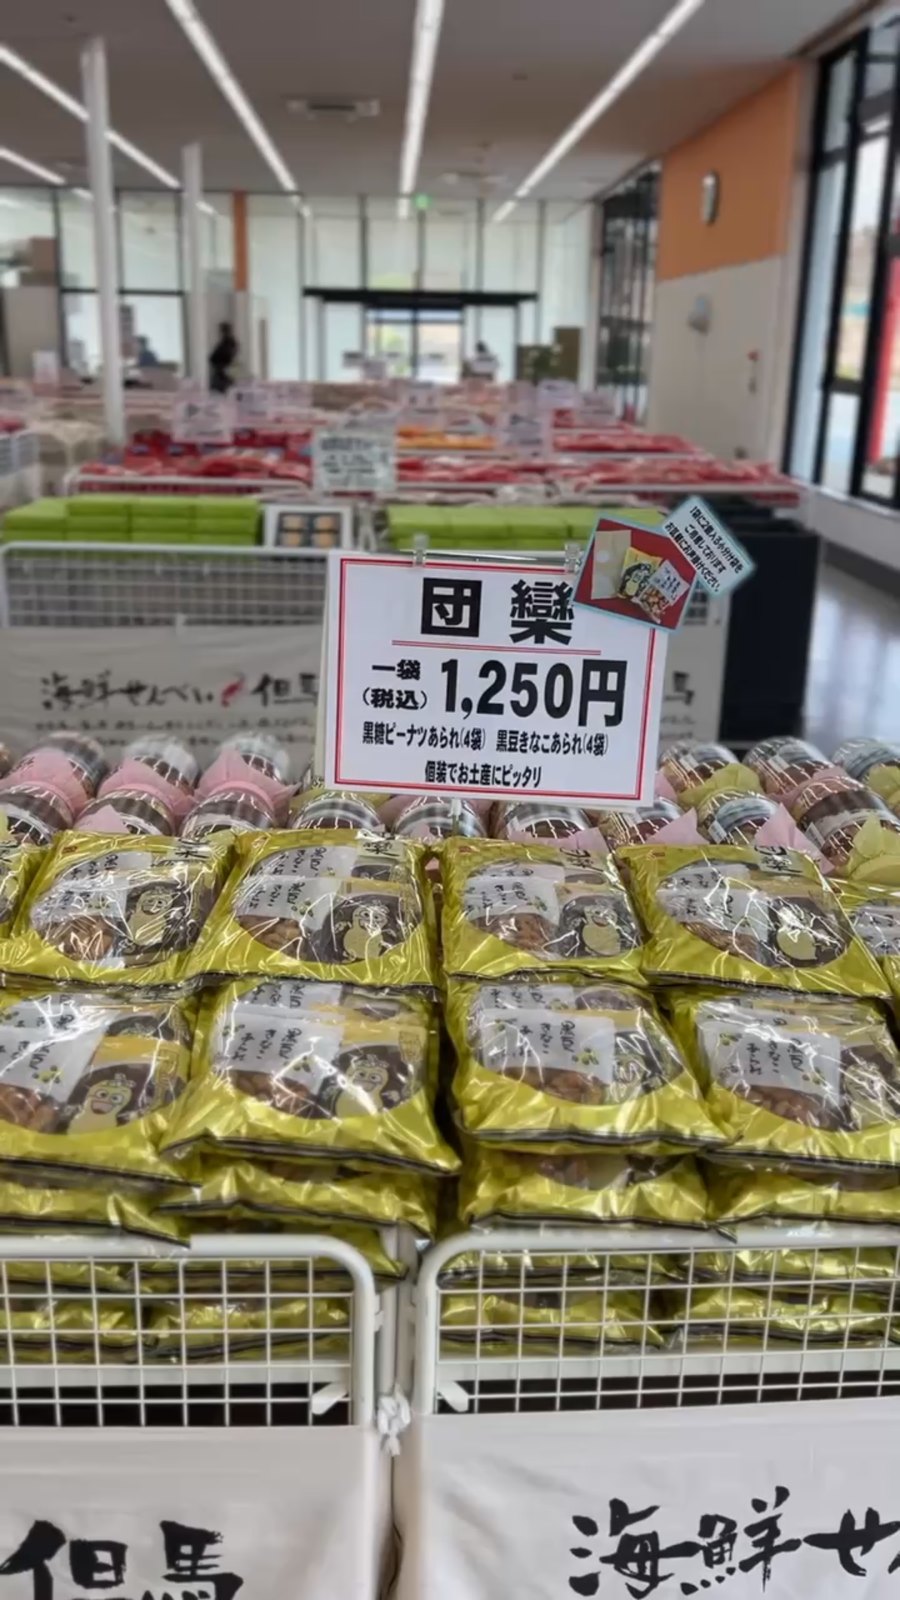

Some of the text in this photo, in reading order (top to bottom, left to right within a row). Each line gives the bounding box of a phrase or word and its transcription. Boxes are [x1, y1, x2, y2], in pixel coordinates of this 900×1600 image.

[372, 659, 421, 680] 一袋
[362, 686, 428, 711] (税込)
[441, 658, 627, 727] 1,250円
[425, 760, 542, 788] 個装でお土産にピッタリ
[569, 1486, 900, 1600] 海鮮せ
